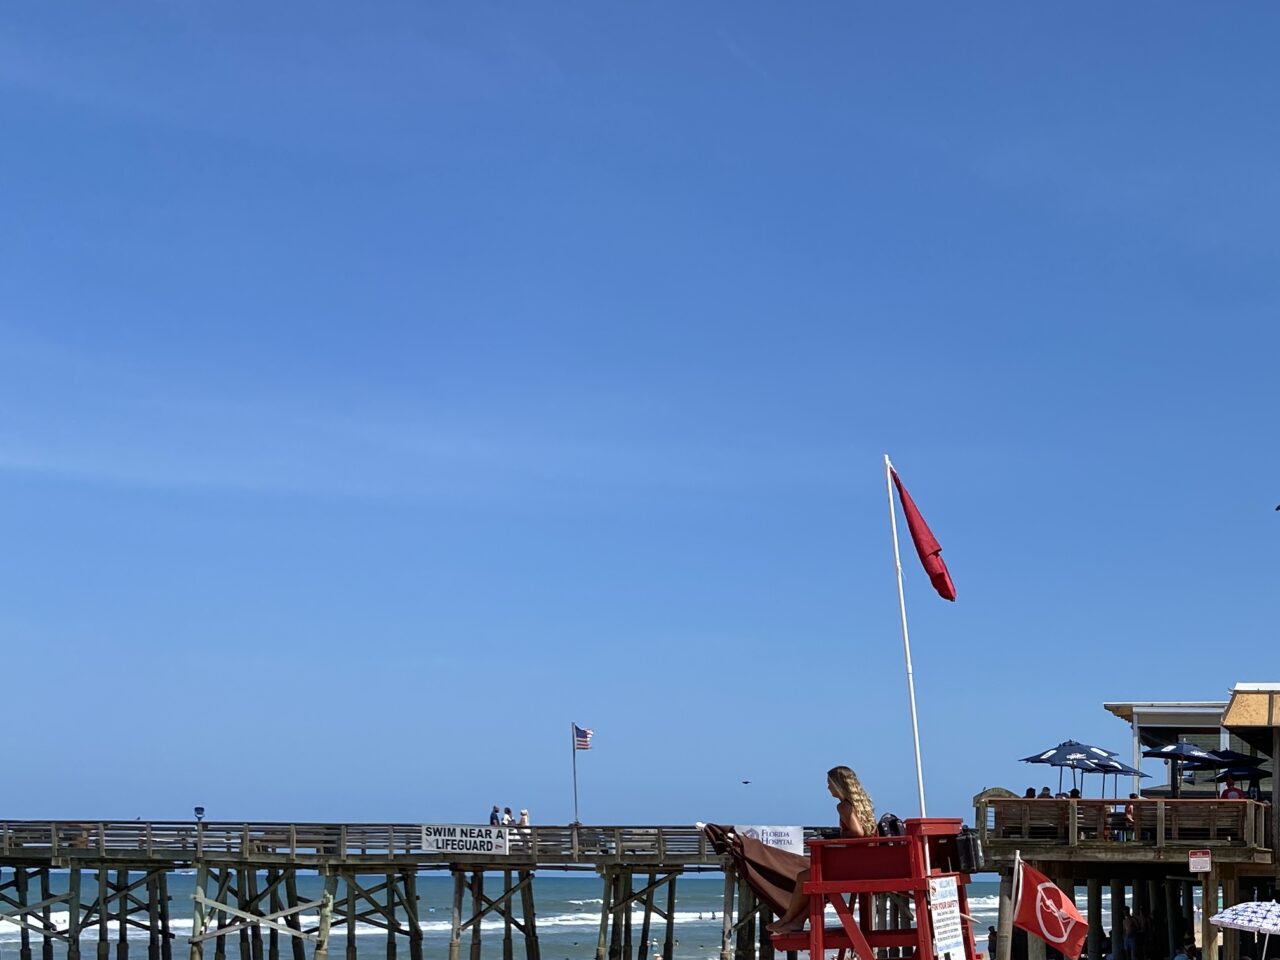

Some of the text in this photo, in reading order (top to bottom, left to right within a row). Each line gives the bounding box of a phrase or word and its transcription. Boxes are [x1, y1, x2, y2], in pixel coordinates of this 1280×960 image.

[425, 826, 504, 839] SWIM NEAR A
[436, 838, 493, 852] LIFEGUARD
